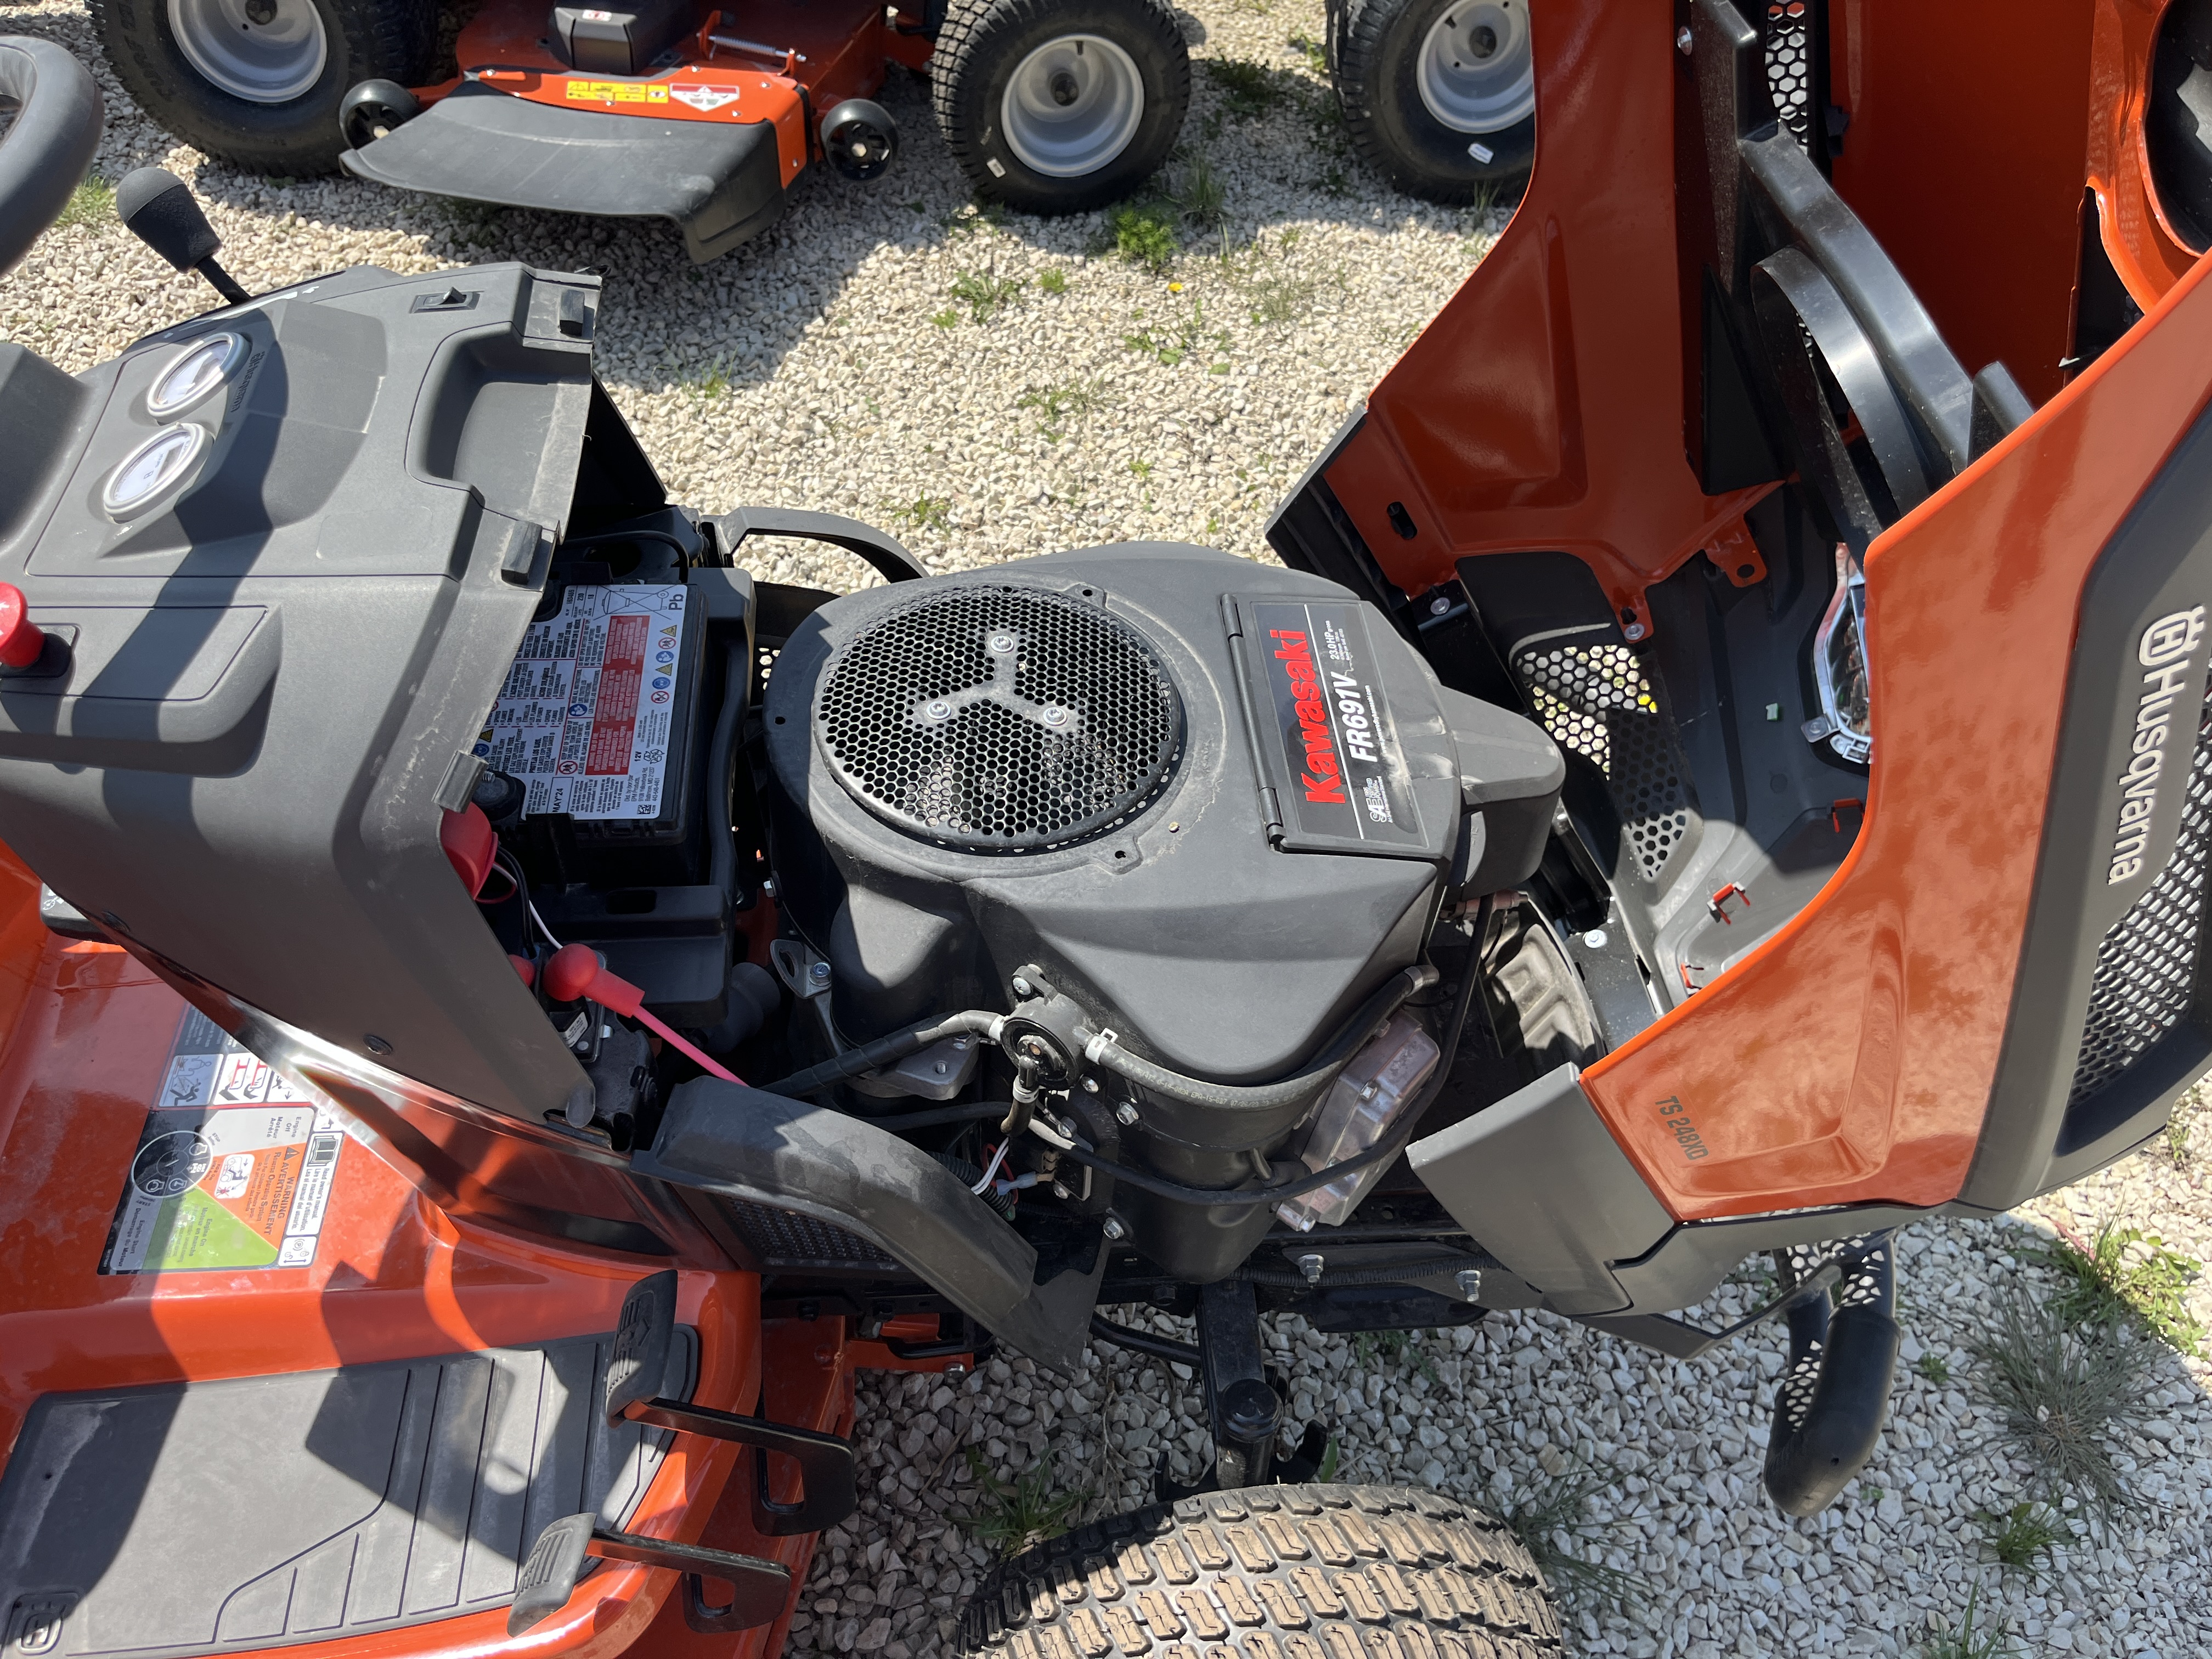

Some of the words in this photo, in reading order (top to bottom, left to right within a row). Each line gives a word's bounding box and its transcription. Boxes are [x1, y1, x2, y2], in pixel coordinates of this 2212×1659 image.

[668, 593, 684, 610] Pb
[1270, 630, 1346, 803] Kawasaki
[1330, 671, 1378, 763] FR691V
[634, 751, 642, 761] 12V
[2108, 659, 2189, 886] Husqvarna
[1655, 1095, 1683, 1115] TS
[266, 1118, 277, 1138] Arrêté
[272, 1116, 284, 1138] Moteur
[284, 1122, 292, 1132] Off
[290, 1116, 302, 1137] Engine
[1666, 1117, 1709, 1160] 248XD
[321, 1167, 330, 1180] Read
[263, 1162, 290, 1235] AVERTISSEMENT
[276, 1176, 295, 1218] WARNING
[197, 1207, 208, 1226] Moteur
[311, 1200, 321, 1219] manual.
[126, 1207, 142, 1238] Démarrage
[133, 1220, 145, 1238] Engine
[201, 1218, 213, 1237] Engine
[129, 1240, 139, 1254] Start
[188, 1235, 200, 1256] marche
[117, 1247, 129, 1267] Moteur
